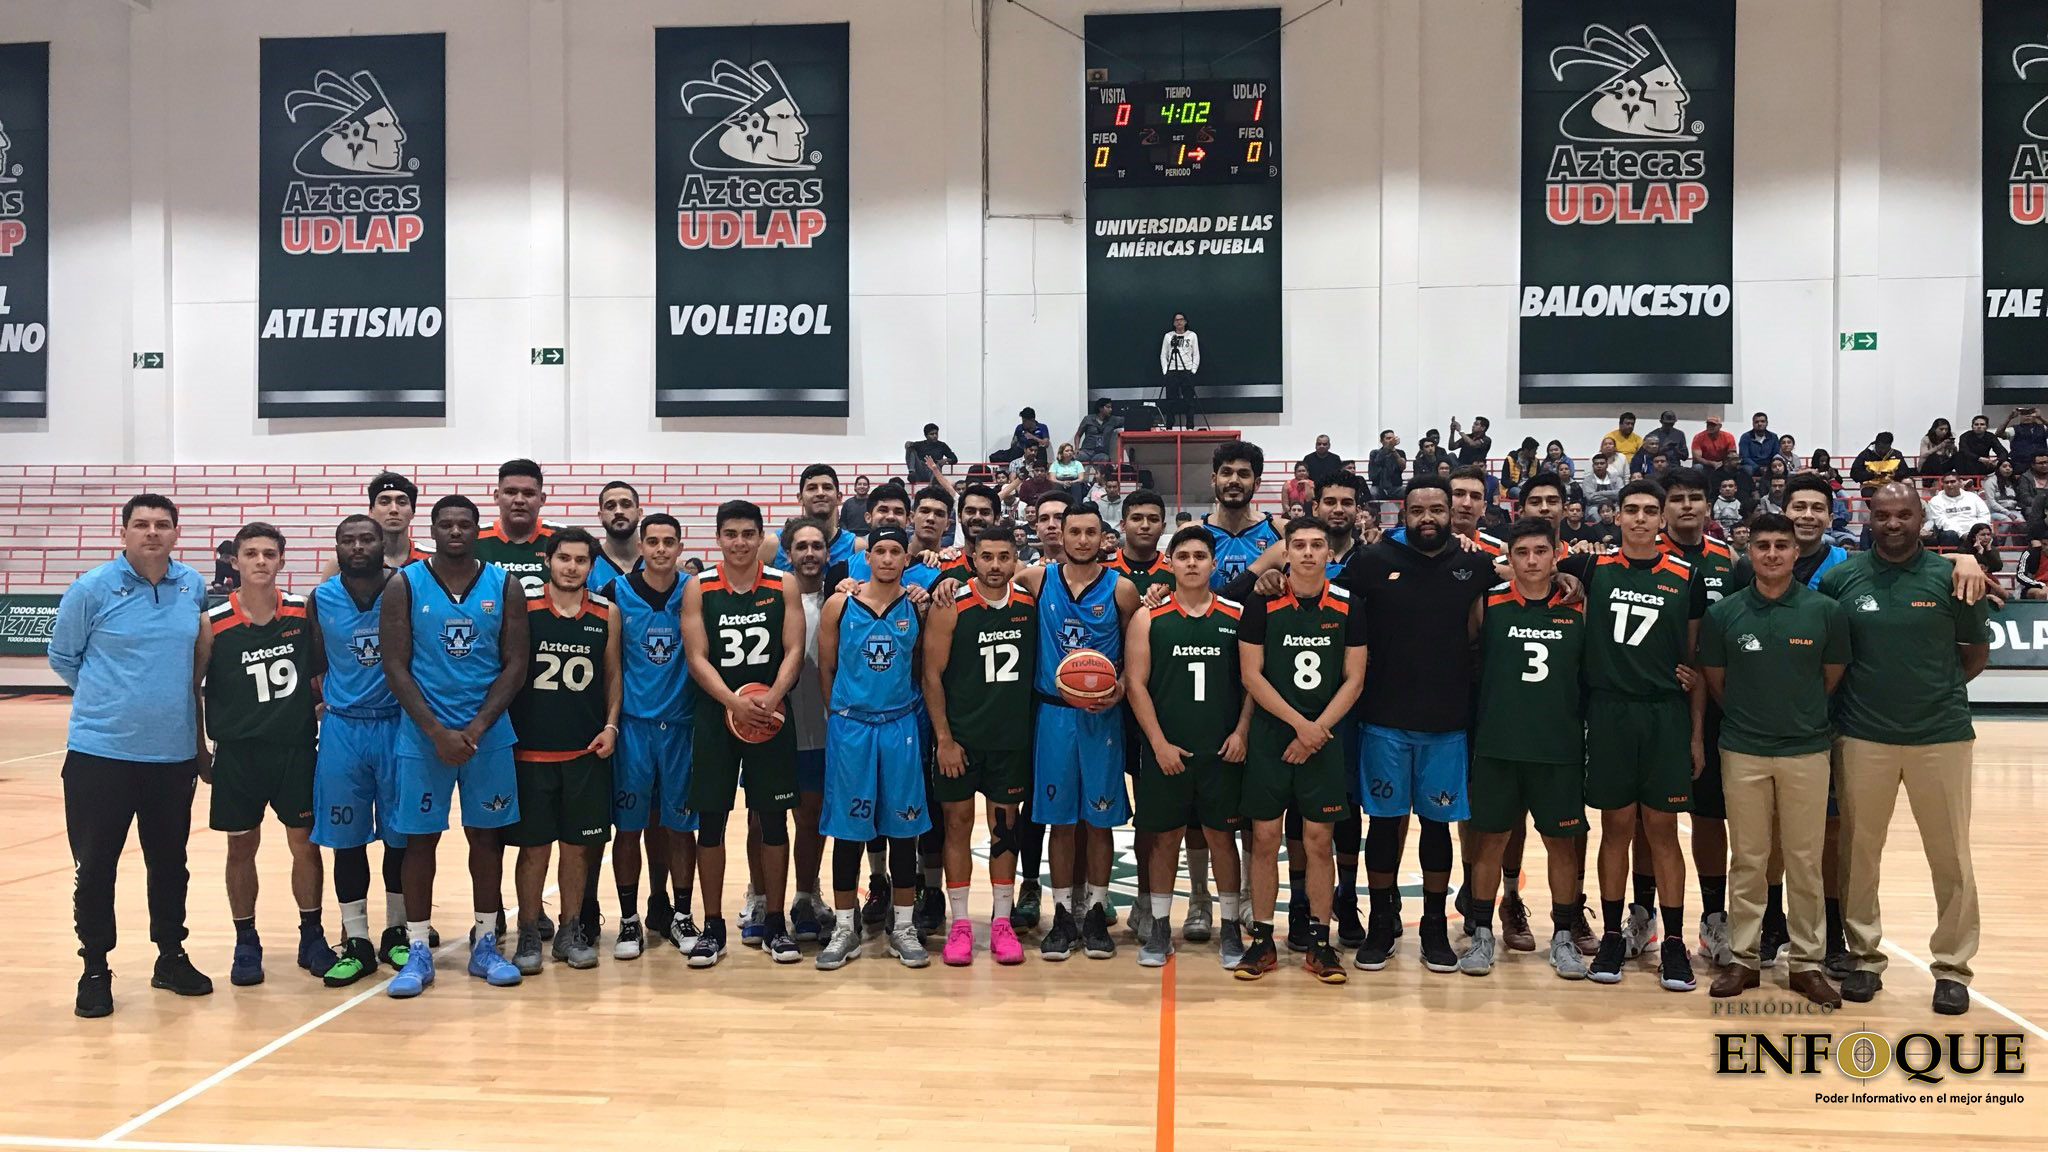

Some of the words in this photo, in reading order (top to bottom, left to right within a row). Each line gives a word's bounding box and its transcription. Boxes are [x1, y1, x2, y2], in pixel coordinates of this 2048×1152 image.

[1100, 88, 1126, 104] VISITA
[1165, 86, 1191, 98] TIEMPO
[1233, 84, 1266, 100] UDLAP
[1115, 104, 1132, 126] 0
[1161, 102, 1210, 124] 4:02
[1254, 100, 1263, 122] 1
[1092, 132, 1118, 144] F/EQ
[1238, 127, 1264, 139] F/EQ
[1094, 146, 1110, 168] 0
[1177, 144, 1186, 165] 1
[1246, 142, 1262, 162] 0
[1546, 144, 1706, 181] Aztecas
[1165, 168, 1190, 177] PERIODO
[282, 182, 421, 214] Aztecas
[678, 174, 822, 208] Aztecas
[1546, 182, 1709, 226] UDLAP
[281, 214, 424, 255] UDLAP
[677, 210, 826, 250] UDLAP
[1095, 218, 1212, 236] UNIVERSIDAD
[1214, 217, 1238, 232] DE
[1240, 215, 1274, 231] LAS
[1106, 237, 1196, 258] AMÉRICAS
[1198, 238, 1264, 255] PUEBLA
[1520, 284, 1730, 317] BALONCESTO
[1986, 288, 2044, 318] TAE
[262, 306, 442, 338] ATLETISMO
[669, 304, 832, 336] VOLEIBOL
[1610, 588, 1664, 606] Aztecas
[1657, 584, 1679, 594] UDLAP
[10, 606, 36, 614] TODOS
[718, 612, 767, 626] Aztecas
[1508, 626, 1562, 640] Aztecas
[1610, 602, 1659, 647] 17
[538, 640, 590, 654] Aztecas
[978, 628, 1022, 644] Aztecas
[1283, 634, 1330, 647] Aztecas
[241, 644, 294, 664] Aztecas
[720, 627, 770, 668] 32
[1172, 645, 1220, 656] Aztecas
[533, 654, 594, 692] 20
[980, 644, 1020, 683] 12
[1293, 650, 1322, 690] 8
[1522, 642, 1550, 682] 3
[246, 658, 298, 703] 19
[1188, 662, 1205, 702] 1
[1046, 784, 1056, 802] 9
[1370, 778, 1394, 800] 26
[420, 792, 432, 814] 5
[616, 790, 638, 811] 20
[850, 798, 872, 820] 25
[330, 806, 354, 827] 50
